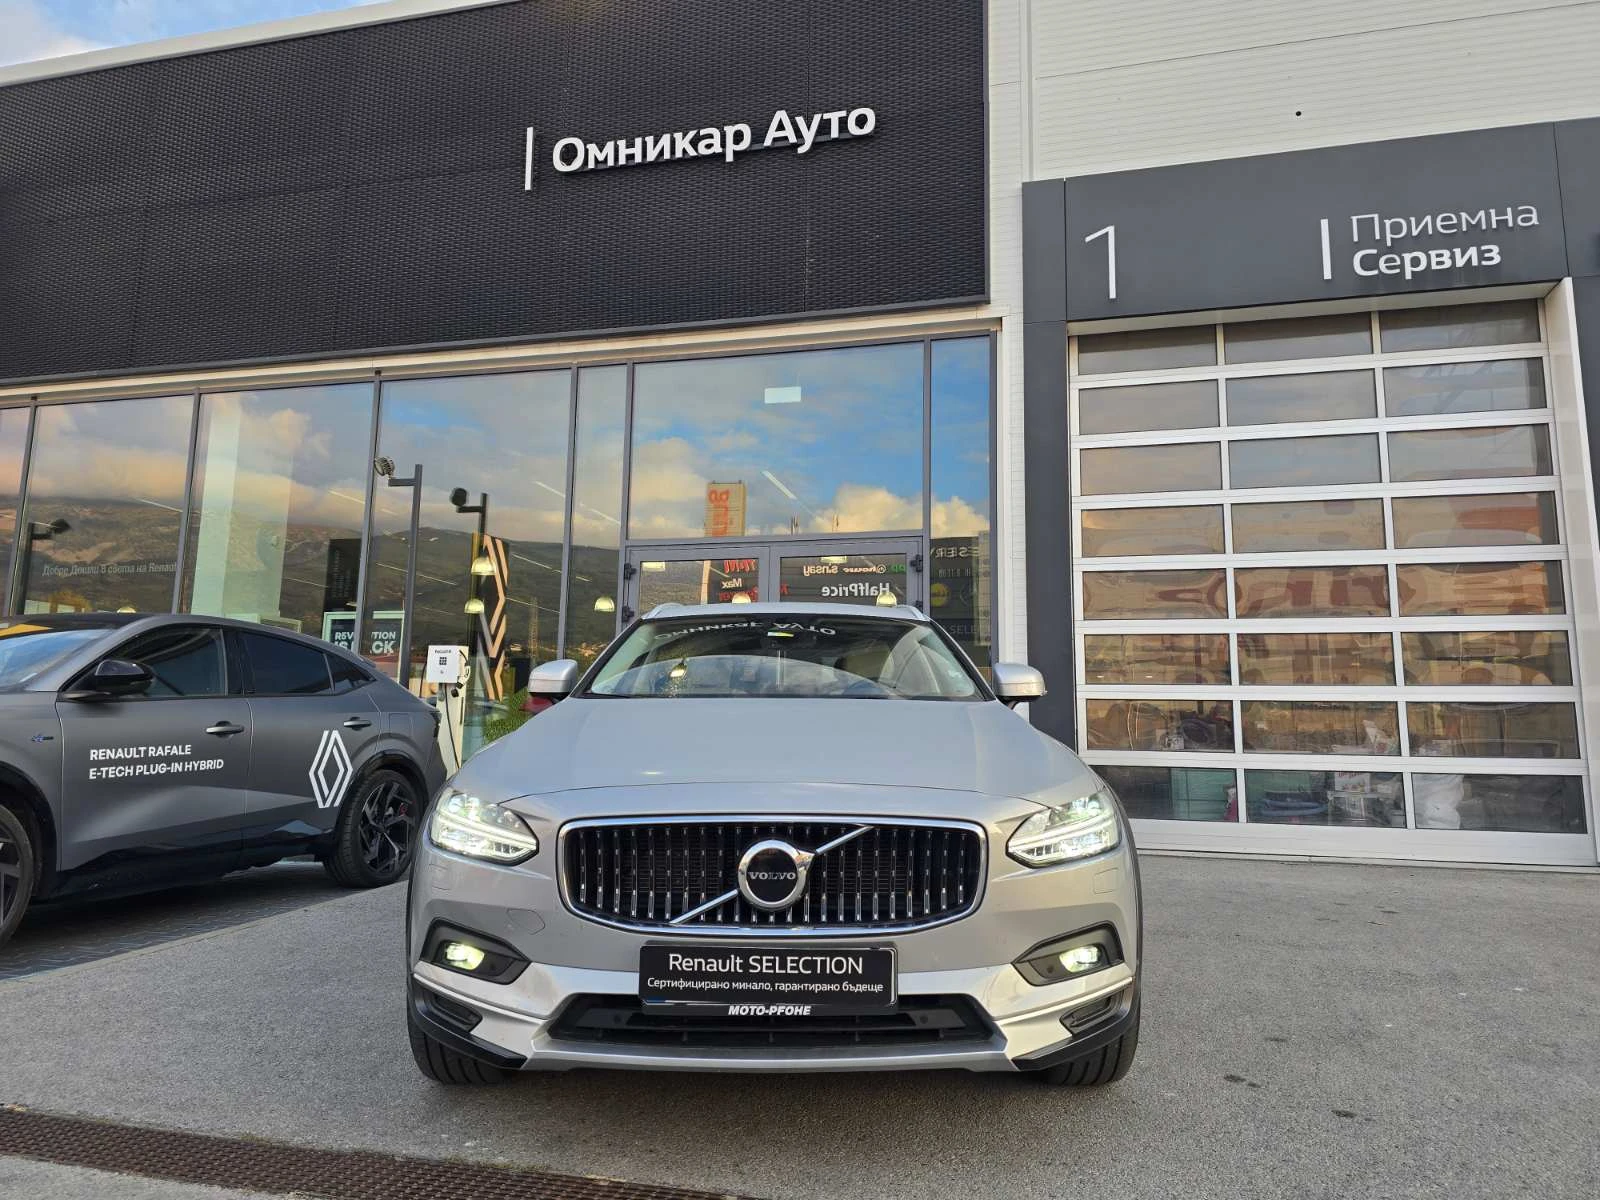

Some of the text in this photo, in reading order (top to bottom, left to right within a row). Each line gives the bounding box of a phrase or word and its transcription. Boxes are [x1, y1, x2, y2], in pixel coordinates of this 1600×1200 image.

[552, 106, 877, 173] Омникар Ауто
[1350, 204, 1540, 246] Приемна
[1084, 225, 1117, 300] 1
[1352, 244, 1502, 280] Сервиз
[89, 744, 192, 761] RENAULT RAFALE
[88, 758, 224, 780] E-TECH PLUG-IN HYBRID
[748, 871, 796, 880] VOLVO
[668, 953, 863, 975] Renault SELECTION
[647, 977, 884, 993] Сертифицирано минало, гарантирано бъдеще
[728, 1005, 811, 1016] MOTO-PFOHE
